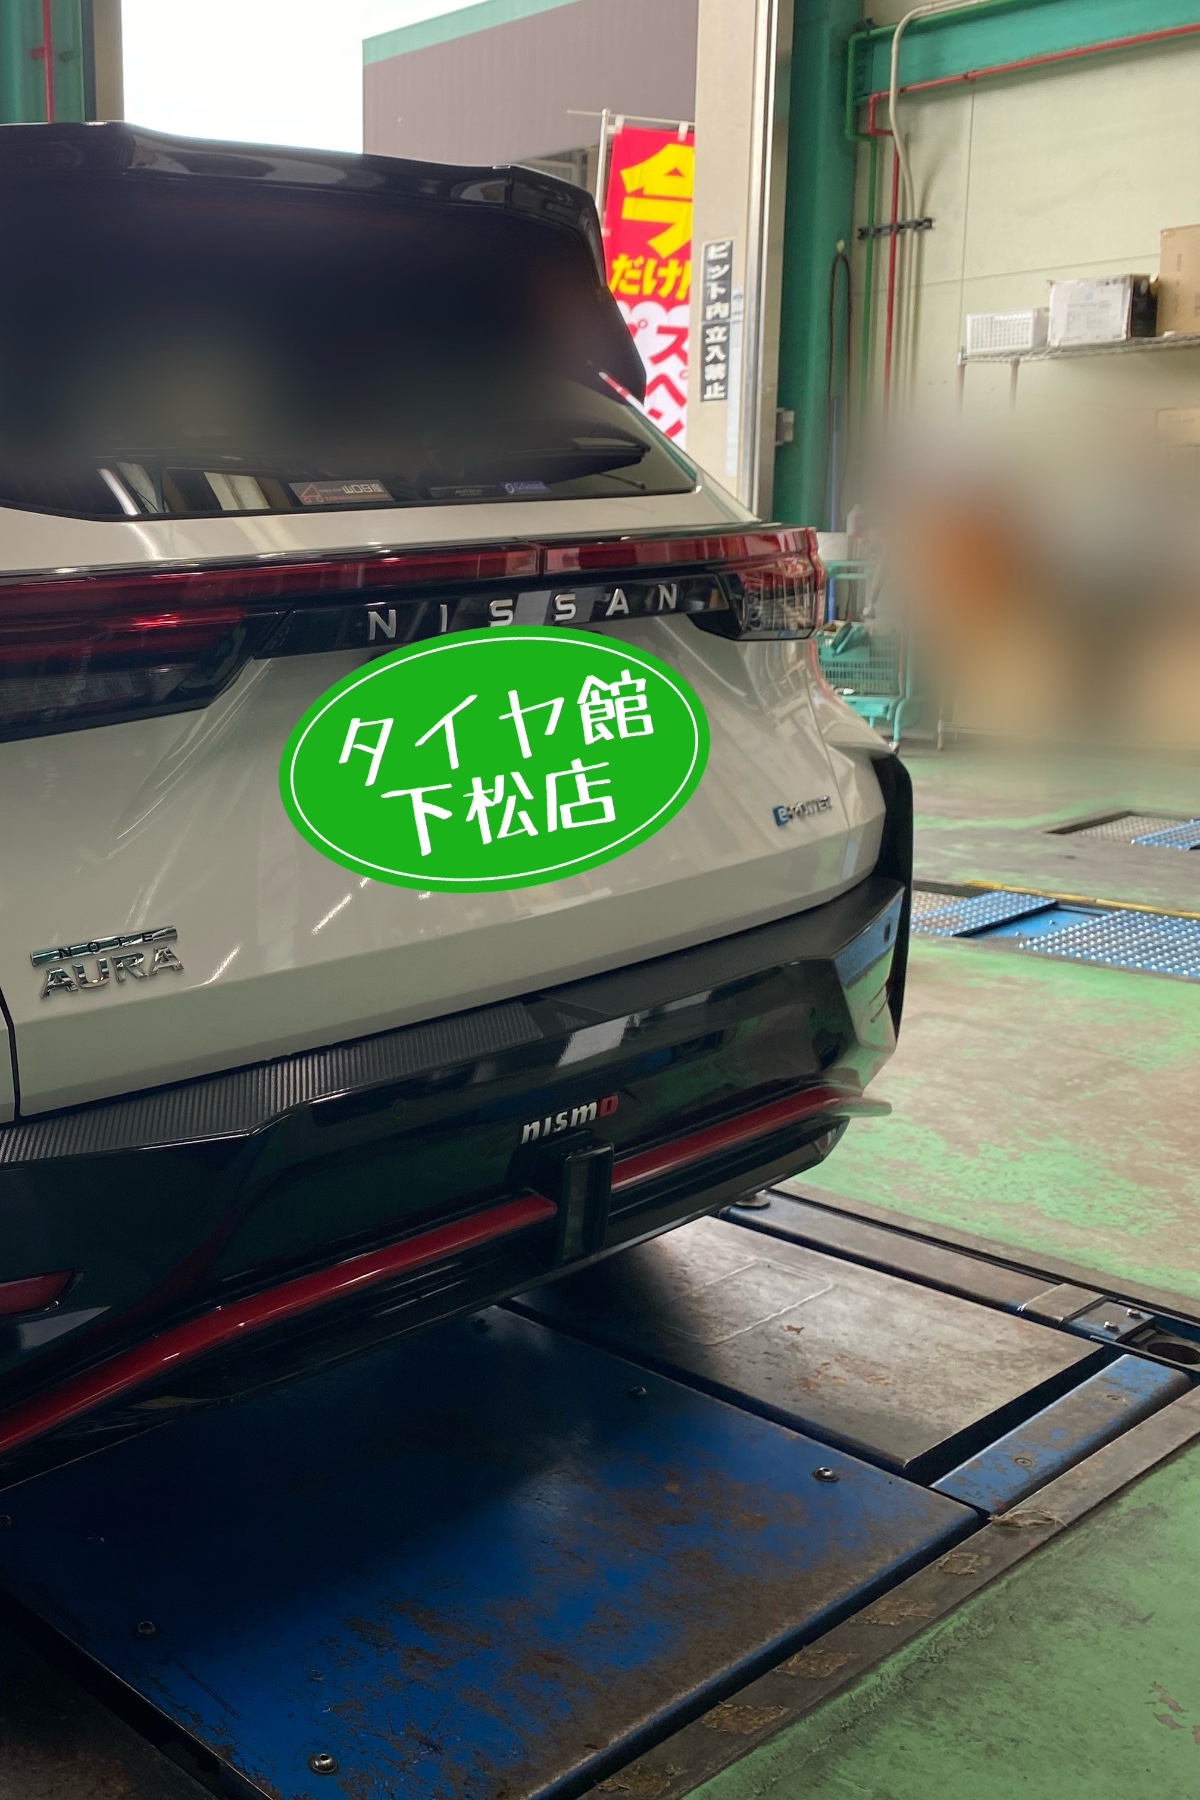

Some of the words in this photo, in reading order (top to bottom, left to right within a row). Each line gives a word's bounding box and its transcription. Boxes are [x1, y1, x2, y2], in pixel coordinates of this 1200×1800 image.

[367, 582, 679, 642] NISSAN
[58, 930, 155, 960] NOTE
[41, 946, 185, 999] AURA
[520, 1093, 619, 1145] nismo
